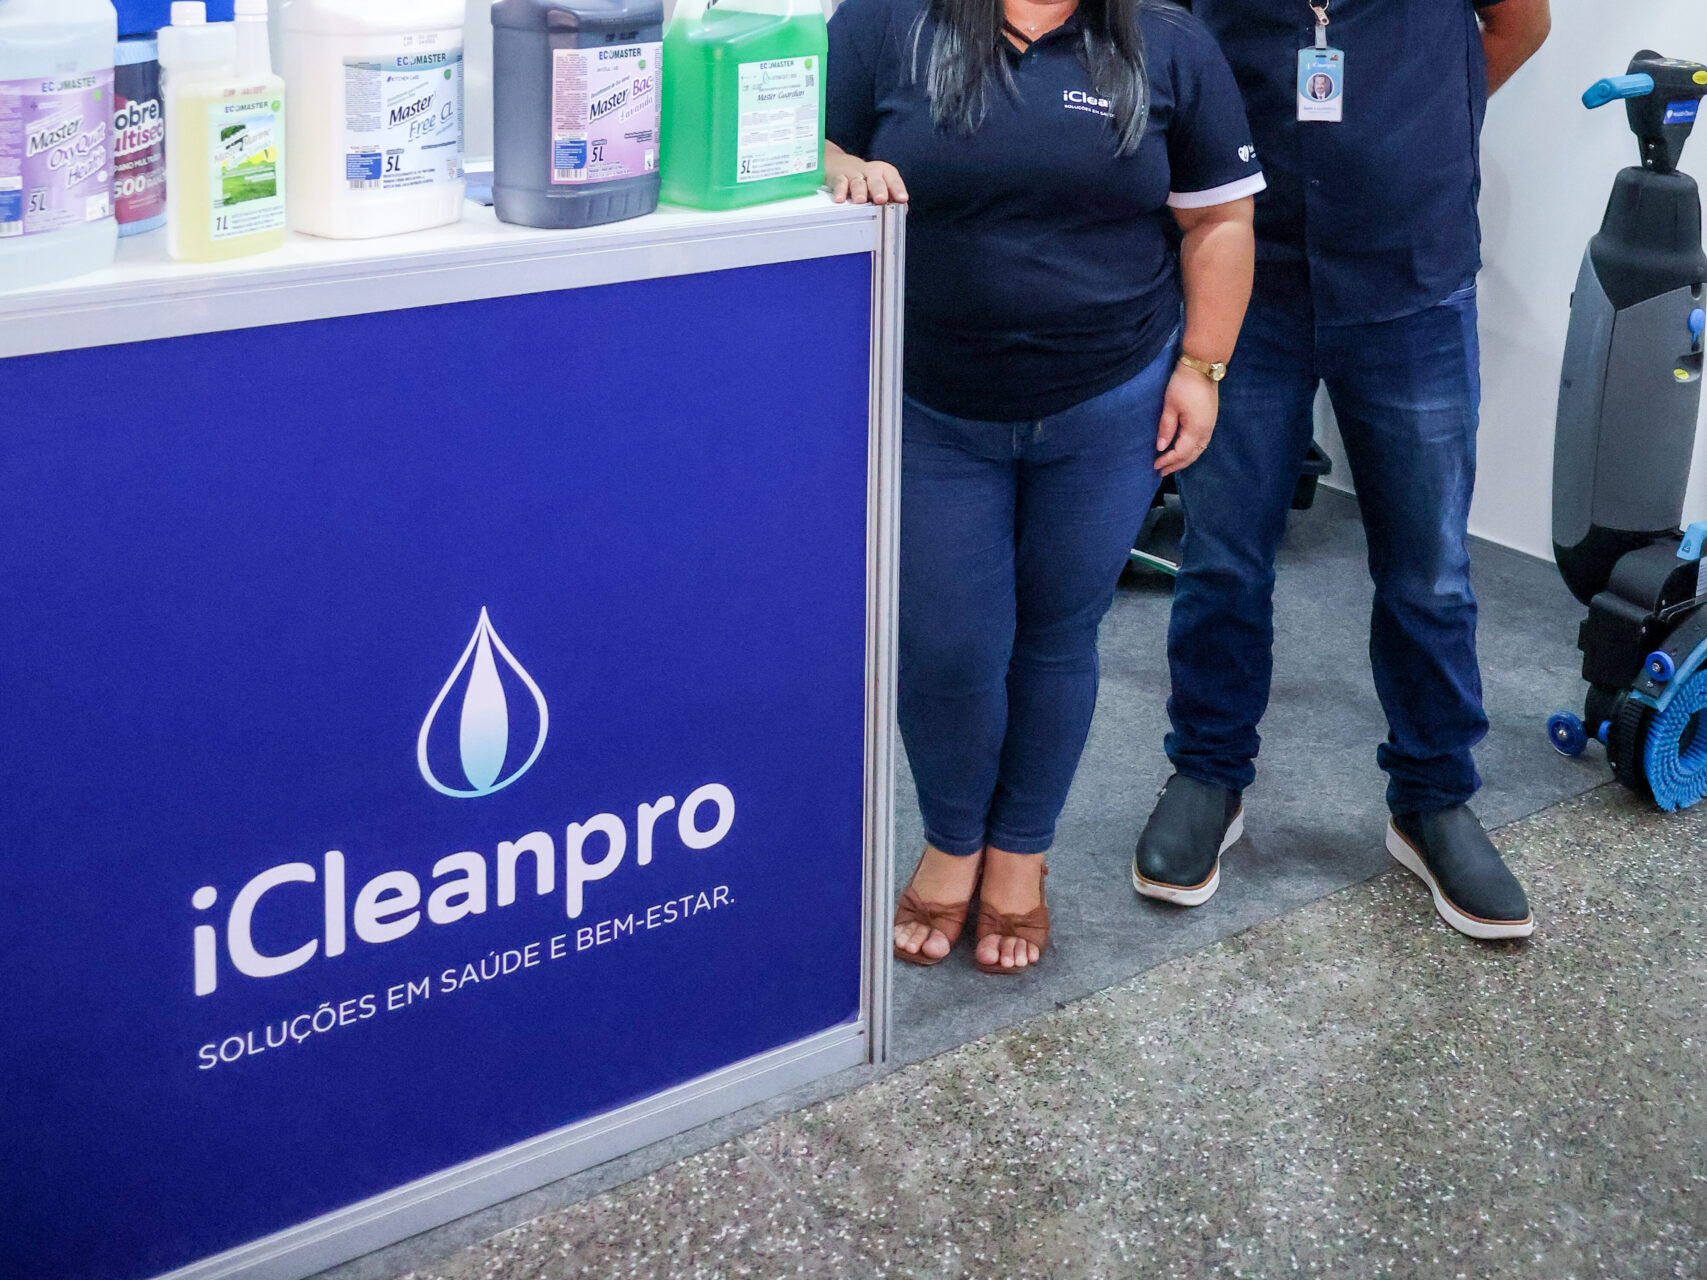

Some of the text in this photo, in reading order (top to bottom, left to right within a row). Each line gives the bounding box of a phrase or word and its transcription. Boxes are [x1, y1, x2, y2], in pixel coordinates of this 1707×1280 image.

[389, 93, 434, 126] Master
[589, 88, 629, 121] Master
[1063, 90, 1110, 108] iClea
[114, 103, 157, 130] obre
[409, 113, 436, 138] Free
[29, 117, 82, 154] Master
[385, 155, 401, 173] 5L
[591, 146, 604, 163] 5L
[741, 160, 751, 174] 5L
[191, 782, 736, 997] iCleanpro
[198, 884, 735, 1070] SOLUÇÕES EM SAÚDE E BEM-ESTAR.
